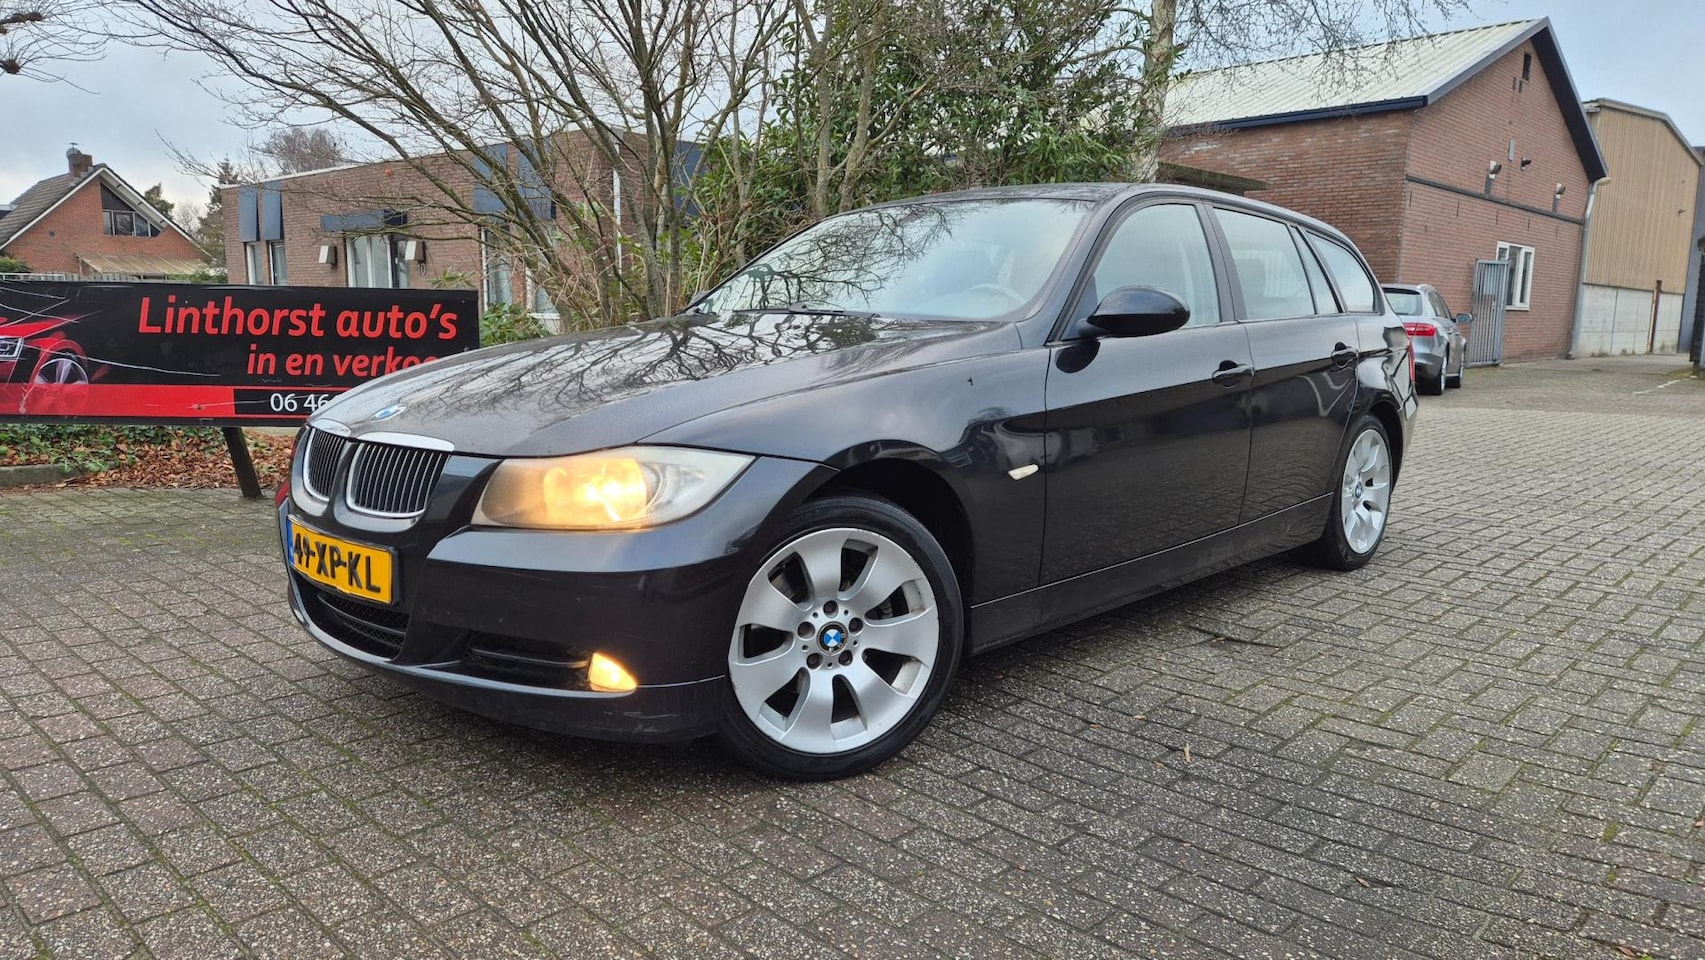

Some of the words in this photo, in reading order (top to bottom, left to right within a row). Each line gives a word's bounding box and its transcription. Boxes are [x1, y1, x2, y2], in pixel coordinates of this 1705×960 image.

[138, 294, 327, 337] Linthorst
[336, 303, 458, 340] auto's
[247, 343, 277, 375] in
[285, 352, 324, 376] en
[333, 346, 438, 377] verko
[270, 392, 298, 412] 06
[294, 532, 382, 593] 49-XP-KL
